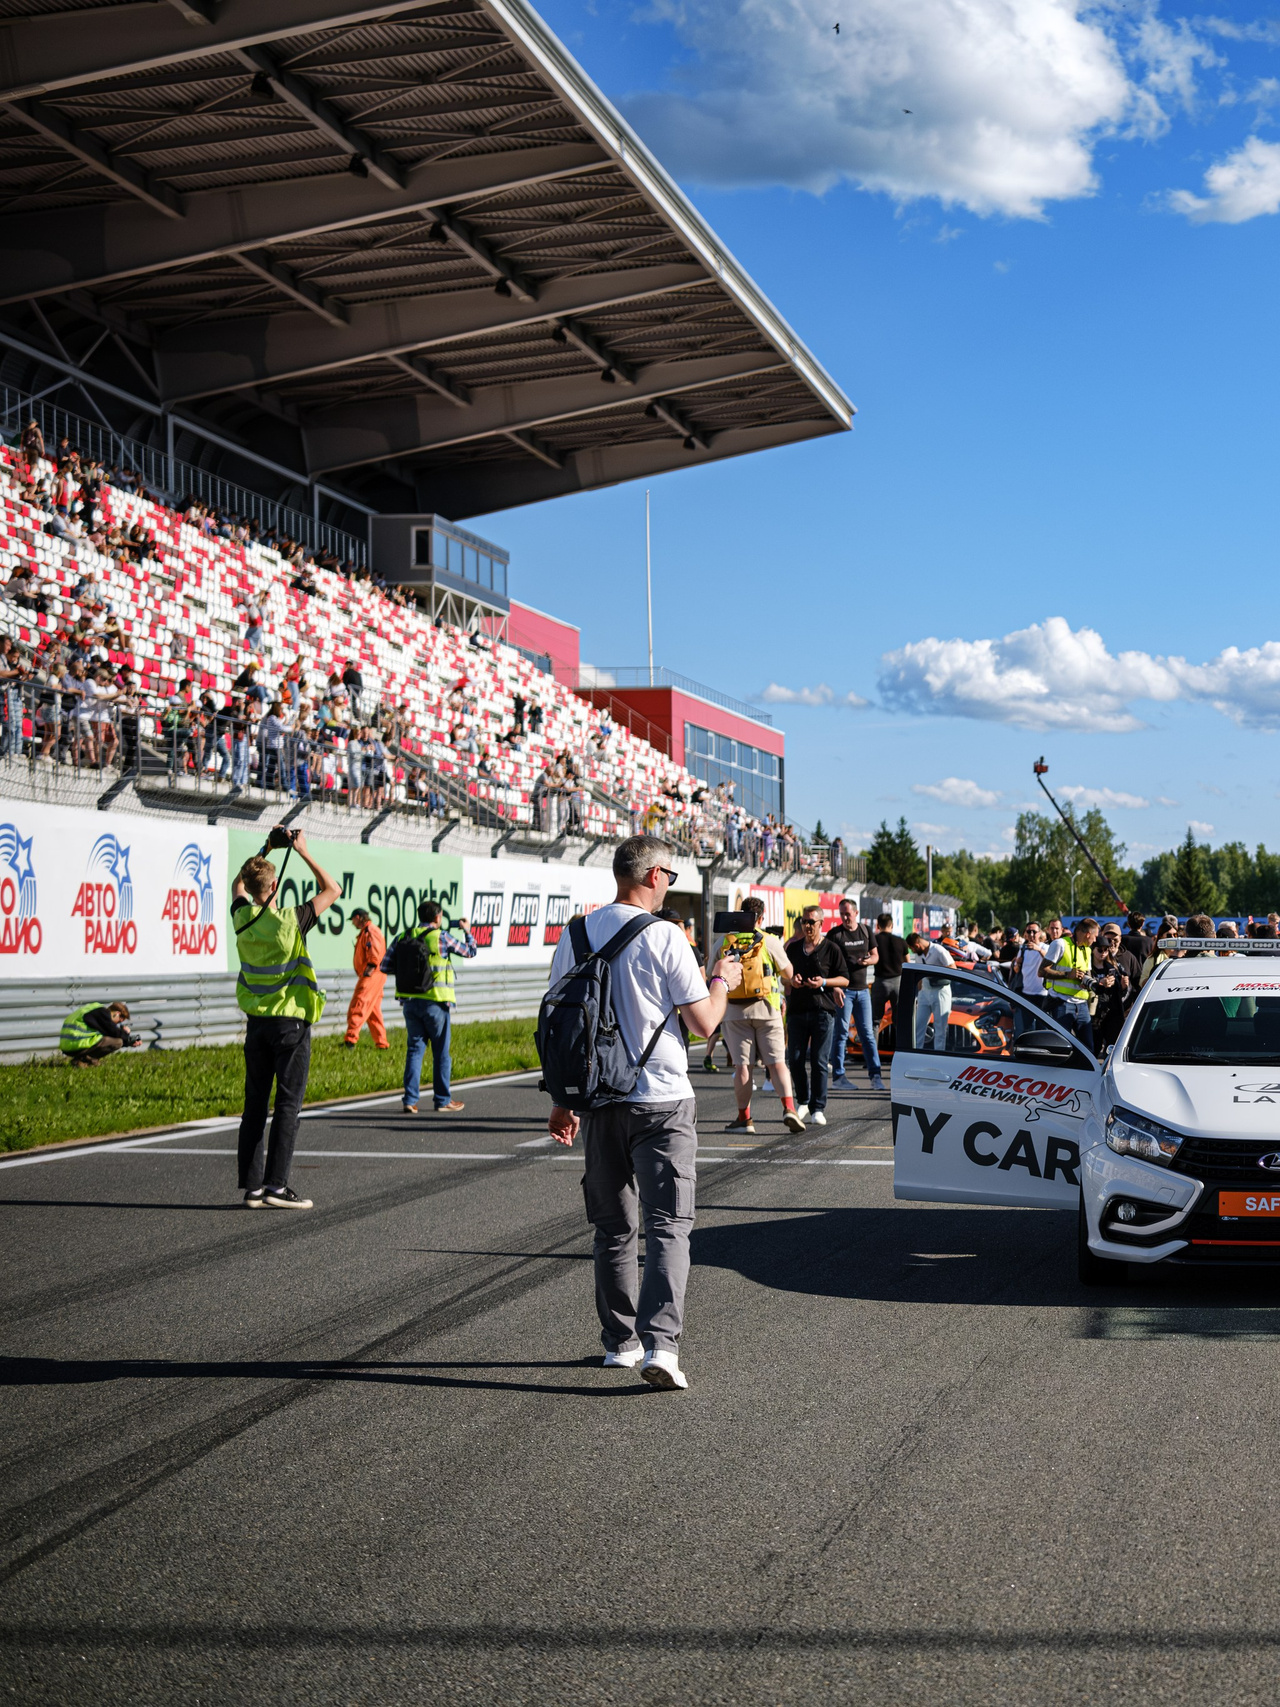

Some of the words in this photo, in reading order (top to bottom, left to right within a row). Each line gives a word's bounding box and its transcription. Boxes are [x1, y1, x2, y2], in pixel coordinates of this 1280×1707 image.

[71, 882, 116, 918] АВТО
[161, 888, 199, 921] АВТО
[472, 895, 502, 924] АВТО
[510, 896, 539, 924] АВТО
[546, 897, 569, 924] АВТО
[0, 917, 42, 954] ДИО
[84, 919, 138, 955] РАДИО
[172, 923, 217, 955] РАДИО
[508, 925, 530, 945] ПЛЮС
[1167, 985, 1210, 993] VESTA
[948, 1079, 1029, 1106] RACEWAY
[957, 1065, 1075, 1103] MOSCOW
[963, 1121, 1081, 1186] CAR
